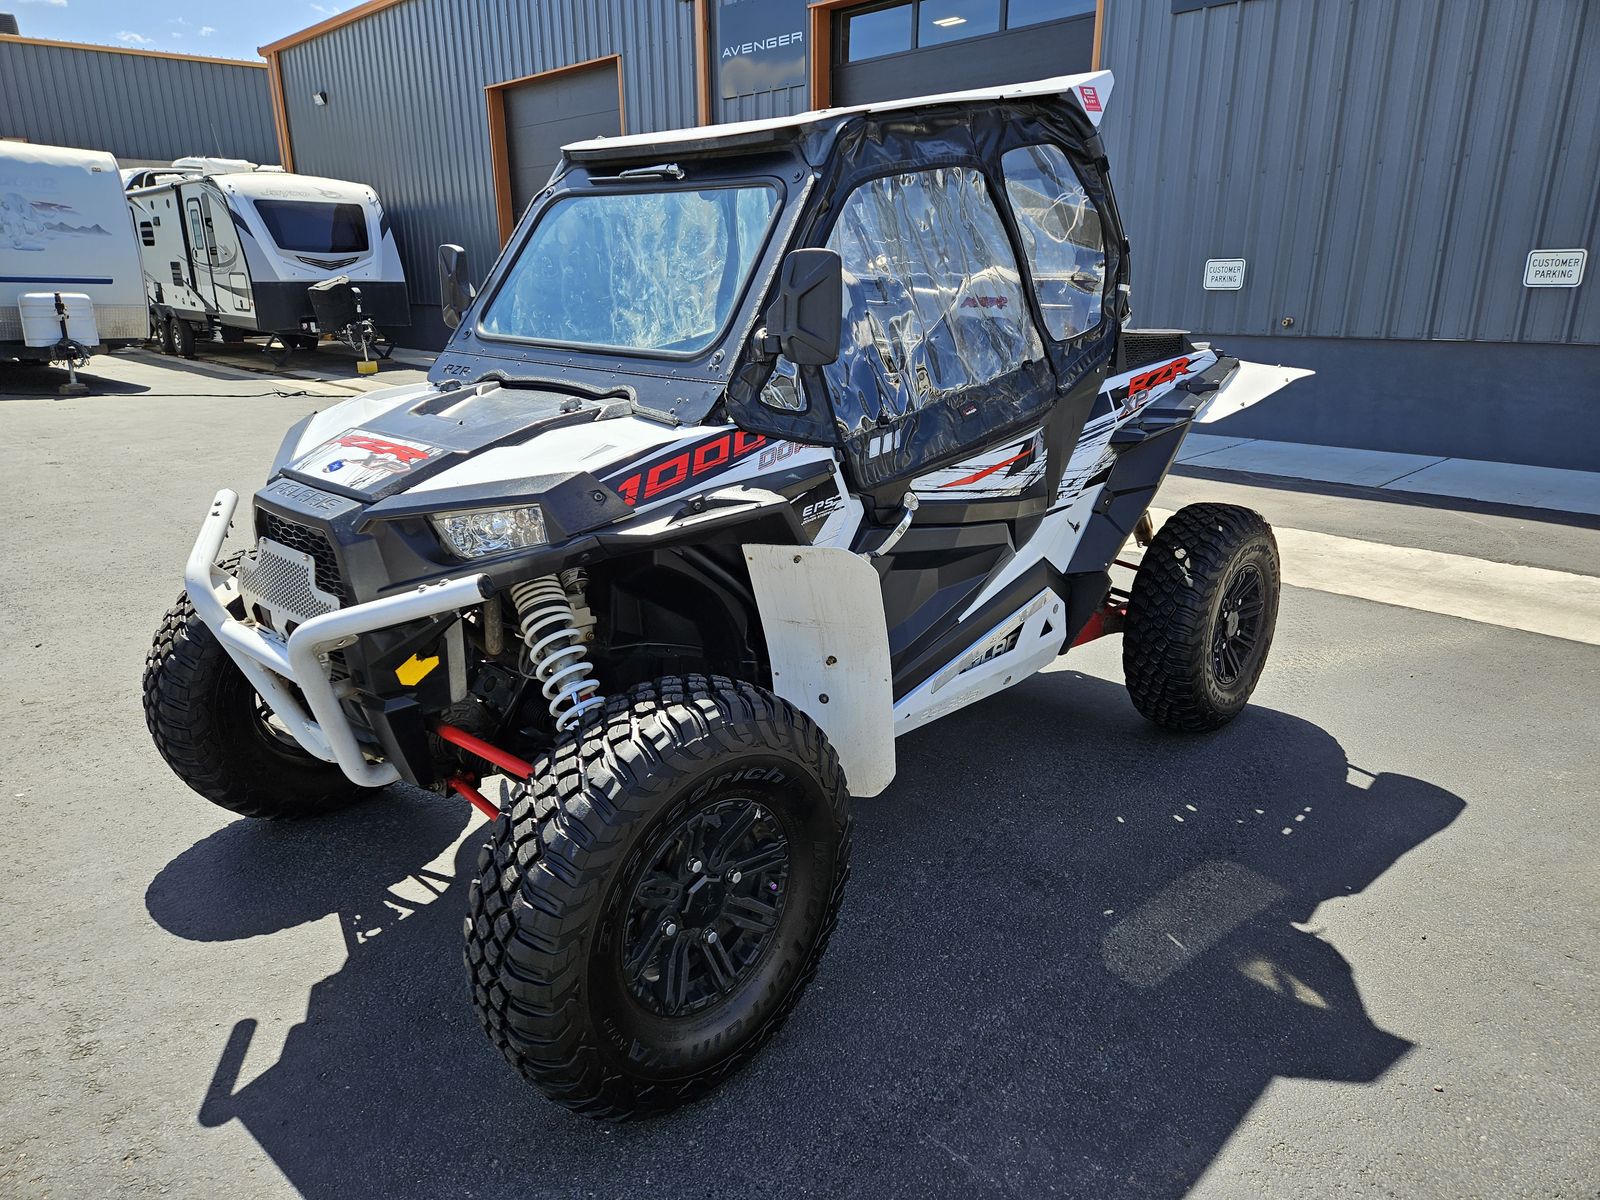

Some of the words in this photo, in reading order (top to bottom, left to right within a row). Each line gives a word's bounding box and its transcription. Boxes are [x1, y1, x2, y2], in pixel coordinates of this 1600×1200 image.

[722, 31, 803, 58] AVENGER
[1532, 258, 1580, 268] CUSTOMER
[1209, 265, 1242, 274] CUSTOMER
[1534, 269, 1573, 279] PARKING
[1210, 275, 1237, 283] PARKING
[1128, 357, 1191, 398] RZR
[803, 496, 834, 517] EPS
